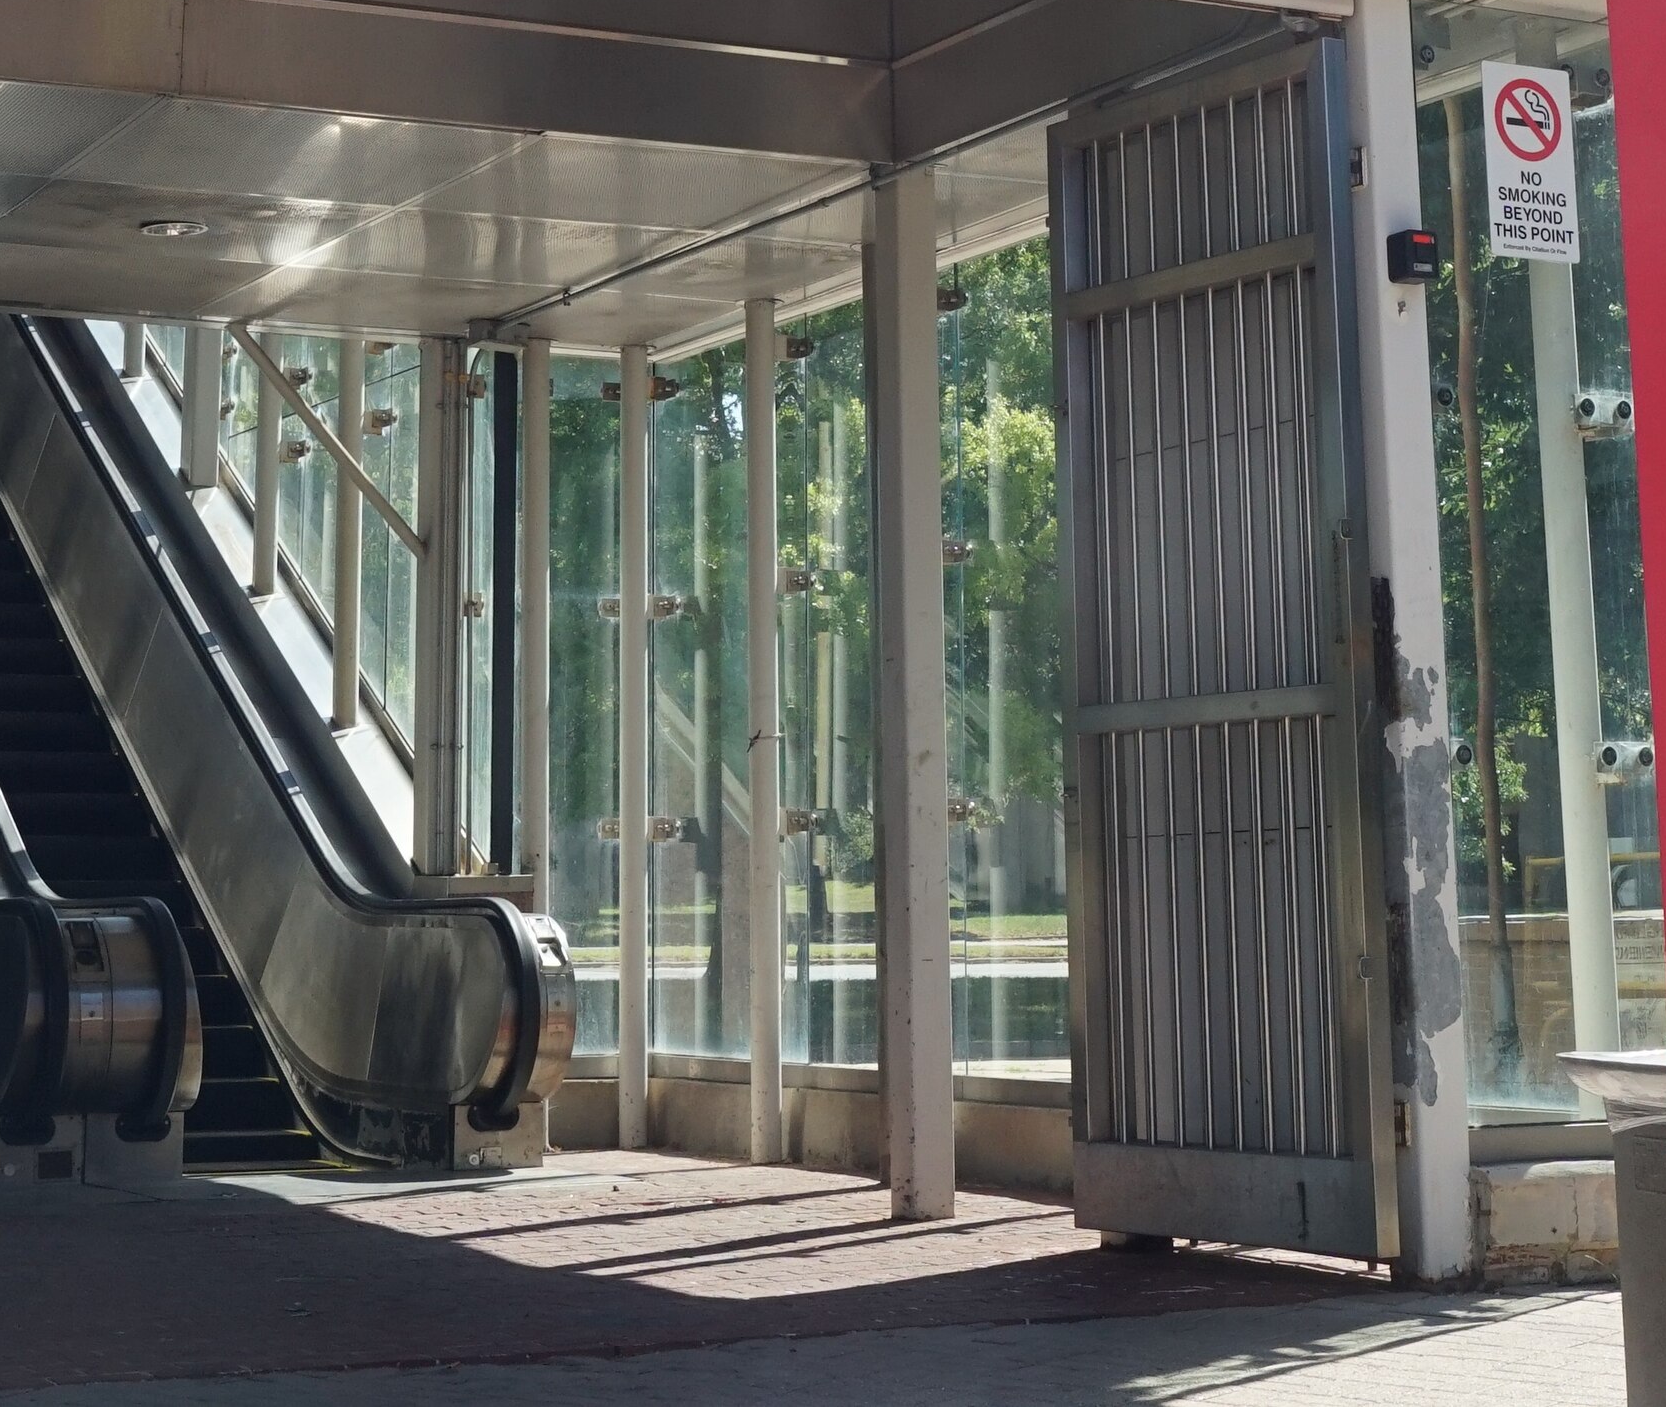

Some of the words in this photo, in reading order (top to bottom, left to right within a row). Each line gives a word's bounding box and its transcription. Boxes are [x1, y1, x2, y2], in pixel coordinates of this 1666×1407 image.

[1521, 171, 1542, 186] NO
[1498, 187, 1566, 207] SMOKING
[1504, 206, 1562, 225] BEYOND
[1494, 223, 1527, 240] THIS
[1531, 228, 1574, 244] POINT
